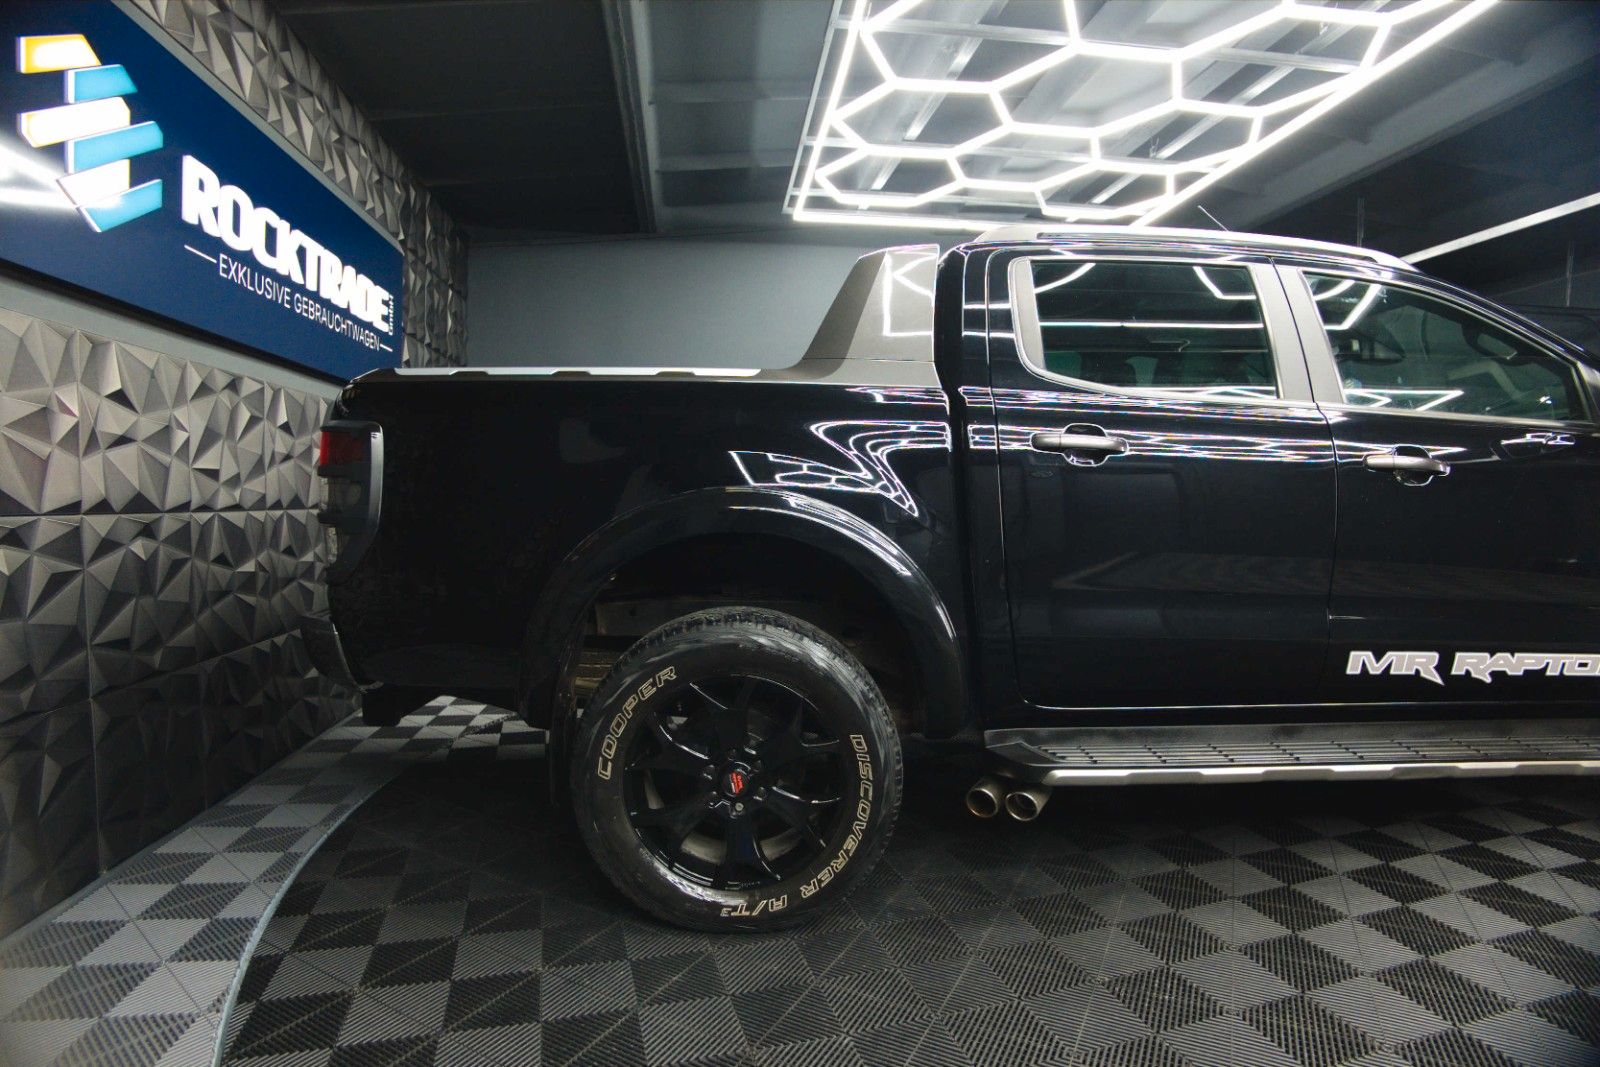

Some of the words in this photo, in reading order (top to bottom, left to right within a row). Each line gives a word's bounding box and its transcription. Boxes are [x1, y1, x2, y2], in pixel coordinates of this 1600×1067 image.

[181, 154, 391, 333] ROCKTRADE
[218, 253, 291, 309] EXKLUSIVE
[293, 293, 380, 351] GEBRAUCHTWAGEN
[597, 666, 677, 780] COOPER
[1346, 651, 1445, 686] MR
[1450, 652, 1600, 684] RAPTO
[799, 734, 873, 899] DISCOVERER
